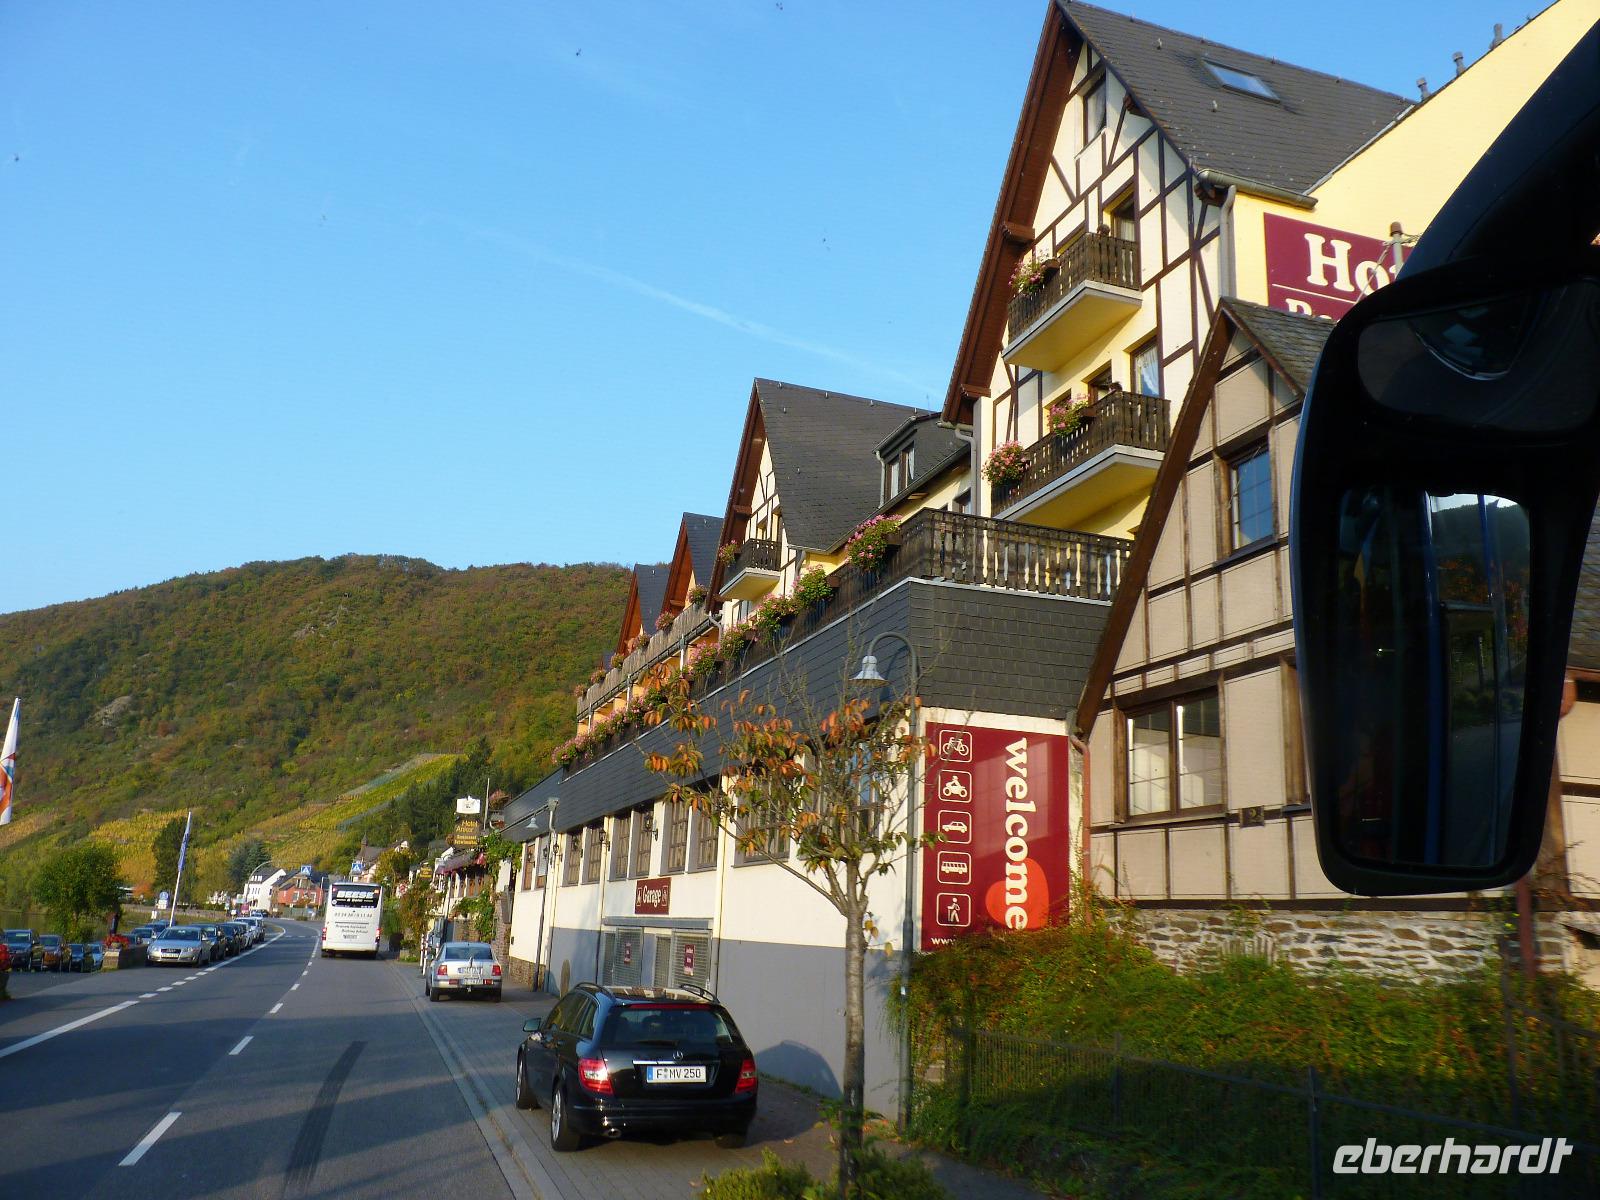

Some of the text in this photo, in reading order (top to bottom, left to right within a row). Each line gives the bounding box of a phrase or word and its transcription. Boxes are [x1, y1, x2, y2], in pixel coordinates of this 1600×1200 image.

[1304, 233, 1398, 296] Ho
[1004, 737, 1036, 930] welcome
[642, 885, 662, 907] Garage
[684, 1068, 701, 1078] 250
